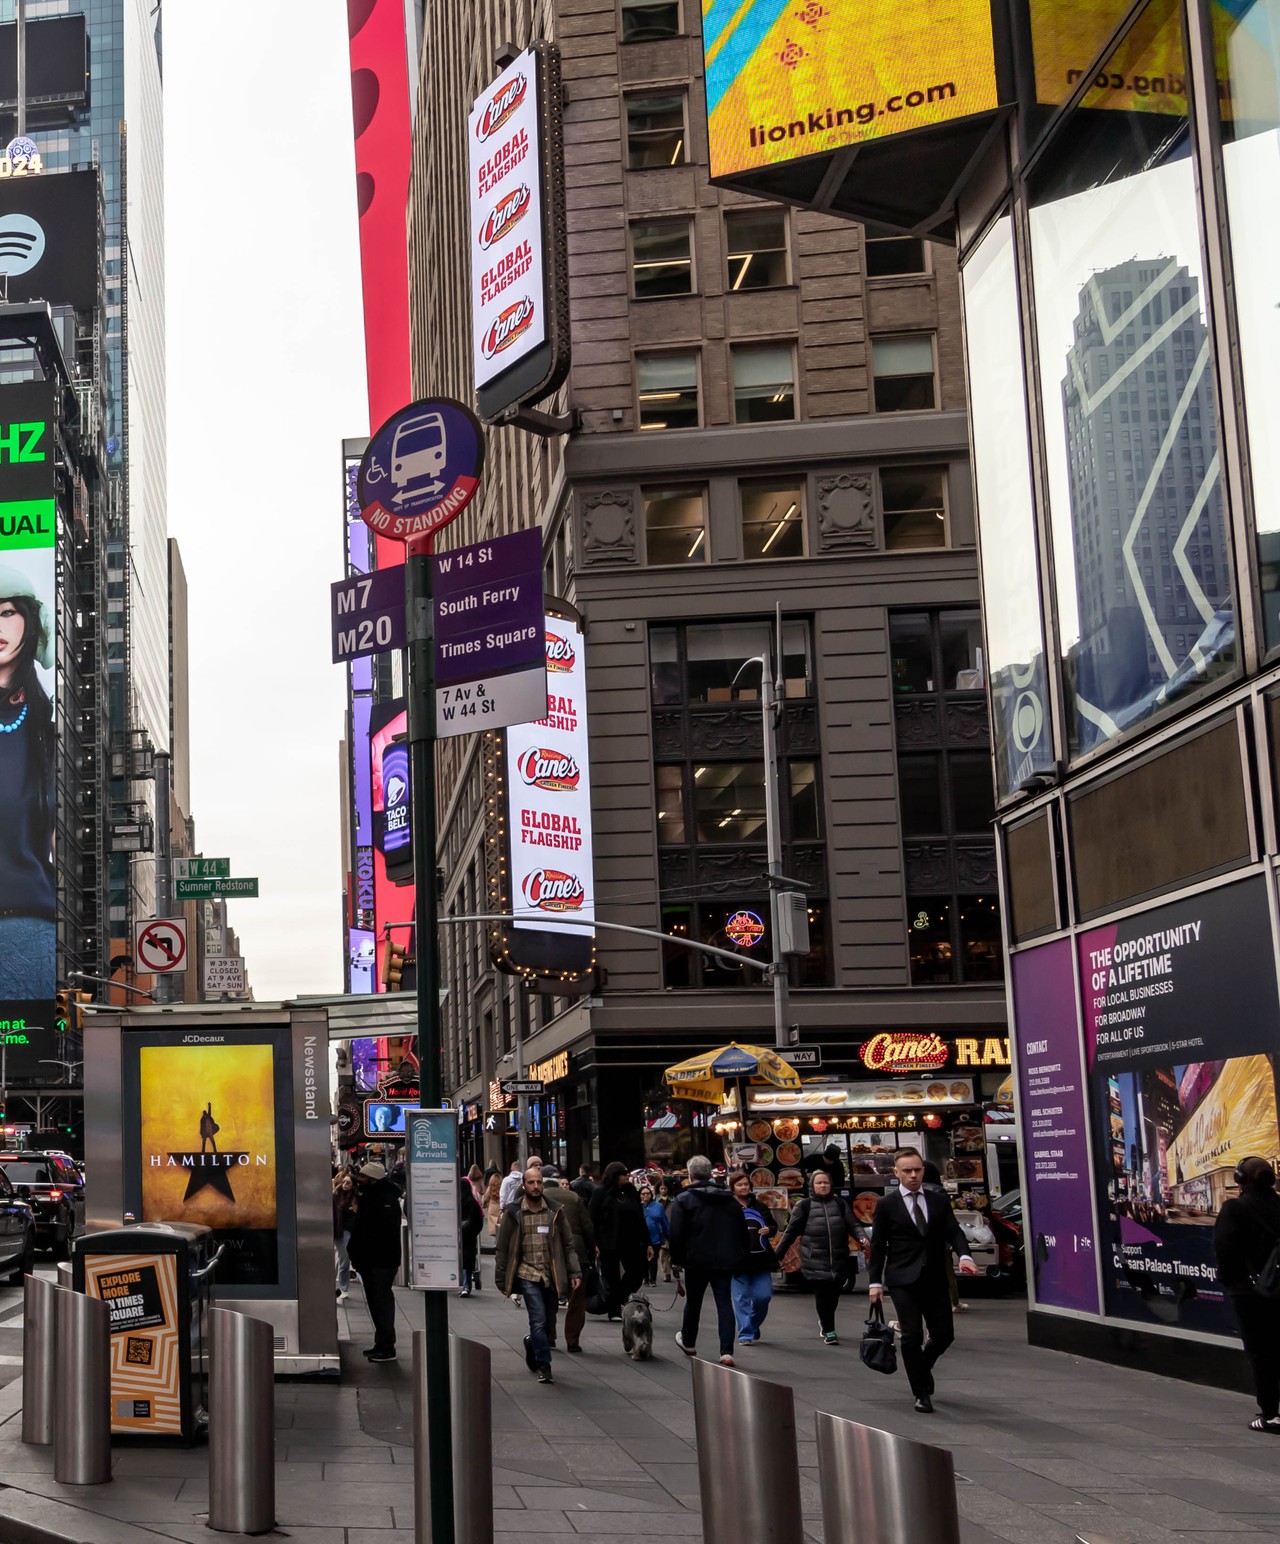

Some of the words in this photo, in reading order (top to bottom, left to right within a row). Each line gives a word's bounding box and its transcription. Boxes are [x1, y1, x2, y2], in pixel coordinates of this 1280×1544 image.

[478, 72, 527, 143] Cane's
[750, 81, 957, 148] lionking.com
[479, 128, 528, 183] GLOBAL
[479, 143, 529, 199] FLAGSHIP
[481, 184, 530, 250] Cane's
[481, 240, 531, 291] GLOBAL
[481, 256, 532, 306] FLAGSHIP
[483, 295, 534, 360] Cane's
[370, 508, 390, 530] NO
[393, 486, 467, 534] STANDING
[439, 560, 452, 573] W
[457, 553, 473, 569] 14
[478, 547, 493, 563] St
[337, 579, 372, 615] M7
[439, 595, 477, 616] South
[483, 586, 520, 607] Ferry
[338, 615, 392, 655] M20
[440, 637, 481, 658] Times
[486, 626, 536, 649] Square
[442, 691, 450, 704] 7
[455, 688, 471, 702] Av
[476, 683, 486, 697] &
[443, 707, 456, 721] W
[461, 702, 476, 717] 44
[482, 699, 495, 713] St
[520, 746, 579, 786] Cane's
[385, 806, 407, 821] TACO
[387, 819, 407, 832] BELL
[521, 809, 581, 835] GLOBAL
[521, 829, 582, 851] FLAGSHIP
[190, 862, 198, 875] W
[202, 861, 217, 875] 44
[357, 852, 374, 909] ROKU
[180, 881, 212, 892] Sumner
[215, 880, 254, 890] Redstone
[525, 867, 585, 907] Cane's
[1090, 948, 1112, 969] THE
[1113, 920, 1201, 964] OPPORTUNITY
[209, 967, 239, 975] CLOSED
[1092, 971, 1106, 991] OF
[1108, 969, 1117, 987] A
[1118, 953, 1172, 985] LIFETIME
[1093, 997, 1106, 1009] FOR
[1107, 991, 1129, 1006] LOCAL
[1130, 980, 1173, 1001] BUSINESSES
[12, 1019, 25, 1029] at
[1095, 1016, 1108, 1027] FOR
[1109, 1006, 1146, 1024] BROADWAY
[182, 1035, 225, 1043] JCDecaux
[1096, 1034, 1109, 1045] FOR
[1110, 1030, 1122, 1042] ALL
[1123, 1028, 1132, 1040] OF
[1134, 1026, 1144, 1038] US
[864, 1033, 947, 1070] Cane's
[1097, 1050, 1128, 1061] ENTERTAINMENT
[1141, 1043, 1169, 1055] SPORTSBOOK
[304, 1036, 318, 1120] Newsstand
[388, 1088, 407, 1096] Hard
[898, 1120, 917, 1128] FAST
[150, 1154, 267, 1167] HAMILTON
[1121, 1244, 1142, 1255] Support
[101, 1271, 141, 1288] EXPLORE
[1145, 1258, 1172, 1273] Palace
[1173, 1260, 1199, 1276] Times
[103, 1285, 129, 1299] MORE
[116, 1294, 144, 1308] TIMES
